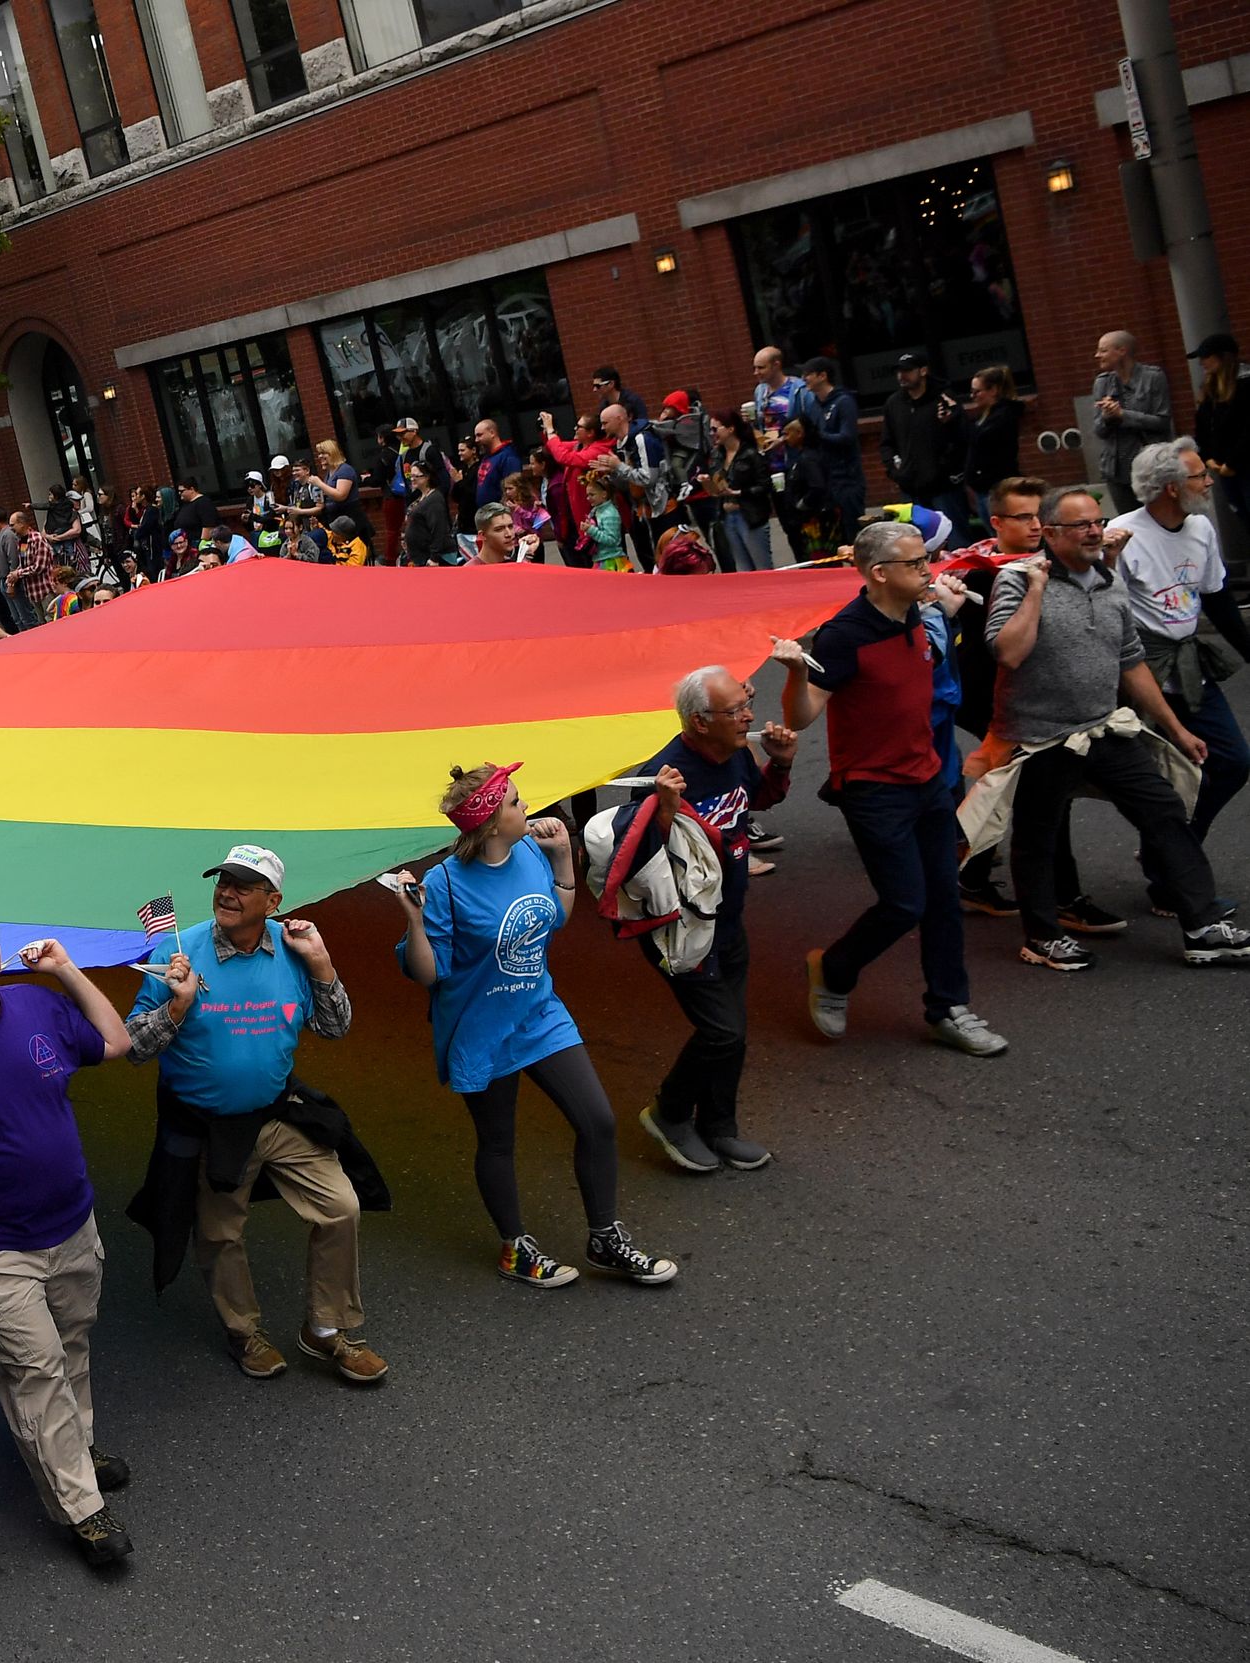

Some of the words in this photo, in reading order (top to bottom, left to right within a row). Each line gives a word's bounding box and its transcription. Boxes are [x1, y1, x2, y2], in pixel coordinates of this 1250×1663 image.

[504, 921, 513, 936] LAW
[509, 903, 525, 921] OFFICE
[533, 898, 546, 906] D.C.
[510, 981, 525, 993] got
[200, 1002, 230, 1013] Pride
[233, 1002, 241, 1012] is
[244, 999, 277, 1011] Power
